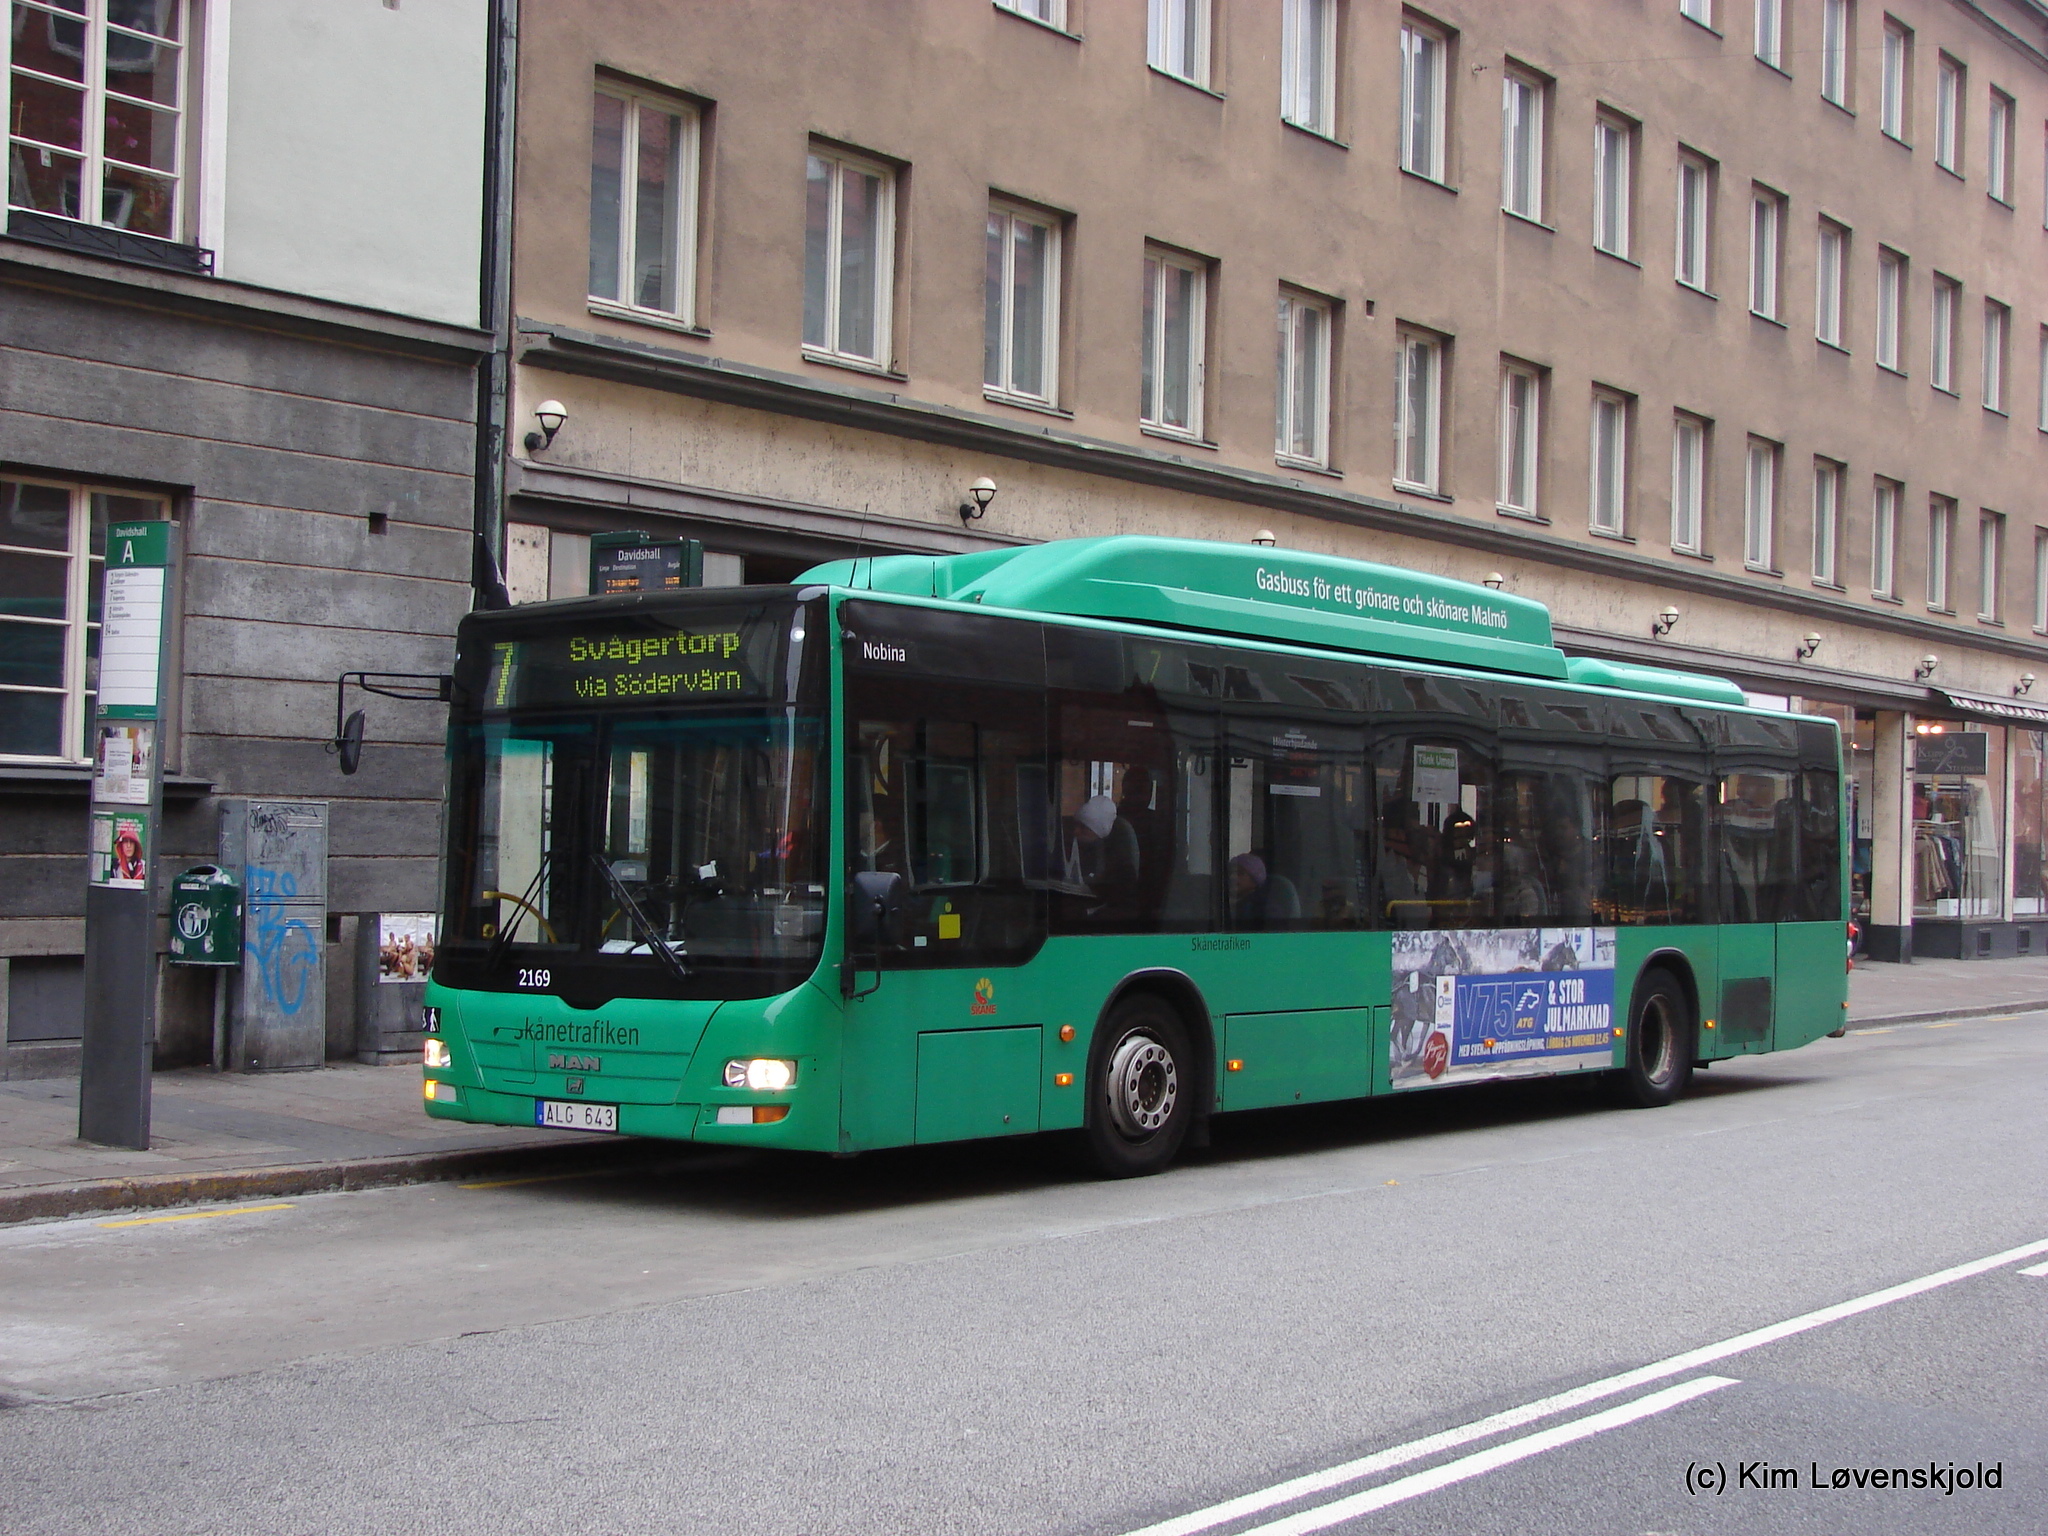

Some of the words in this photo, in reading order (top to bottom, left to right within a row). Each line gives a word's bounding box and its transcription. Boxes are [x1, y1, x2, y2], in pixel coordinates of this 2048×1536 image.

[116, 527, 147, 537] Davidshall
[123, 540, 134, 563] A
[618, 548, 660, 561] Davidshall
[1256, 567, 1310, 597] Gasbuss
[1313, 577, 1331, 600] för
[1334, 584, 1352, 604] ett
[1355, 586, 1400, 611] grönare
[1403, 594, 1423, 616] och
[1426, 596, 1469, 623] skönare
[1471, 604, 1508, 629] Malmö
[570, 630, 739, 664] Svågertorp
[863, 641, 906, 662] Nobina
[494, 642, 513, 705] 7
[576, 676, 607, 697] via
[615, 669, 741, 695] Södervärn
[1191, 936, 1250, 951] Skånetrafiken
[519, 969, 550, 987] 2169
[1547, 979, 1556, 1005] &
[1559, 978, 1584, 1004] STOR
[1457, 981, 1513, 1040] V75
[1544, 1003, 1610, 1032] JULMARKNAD
[1516, 1017, 1534, 1029] ATG
[549, 1054, 601, 1072] MAN
[546, 1104, 574, 1124] ALG
[585, 1107, 613, 1127] 643
